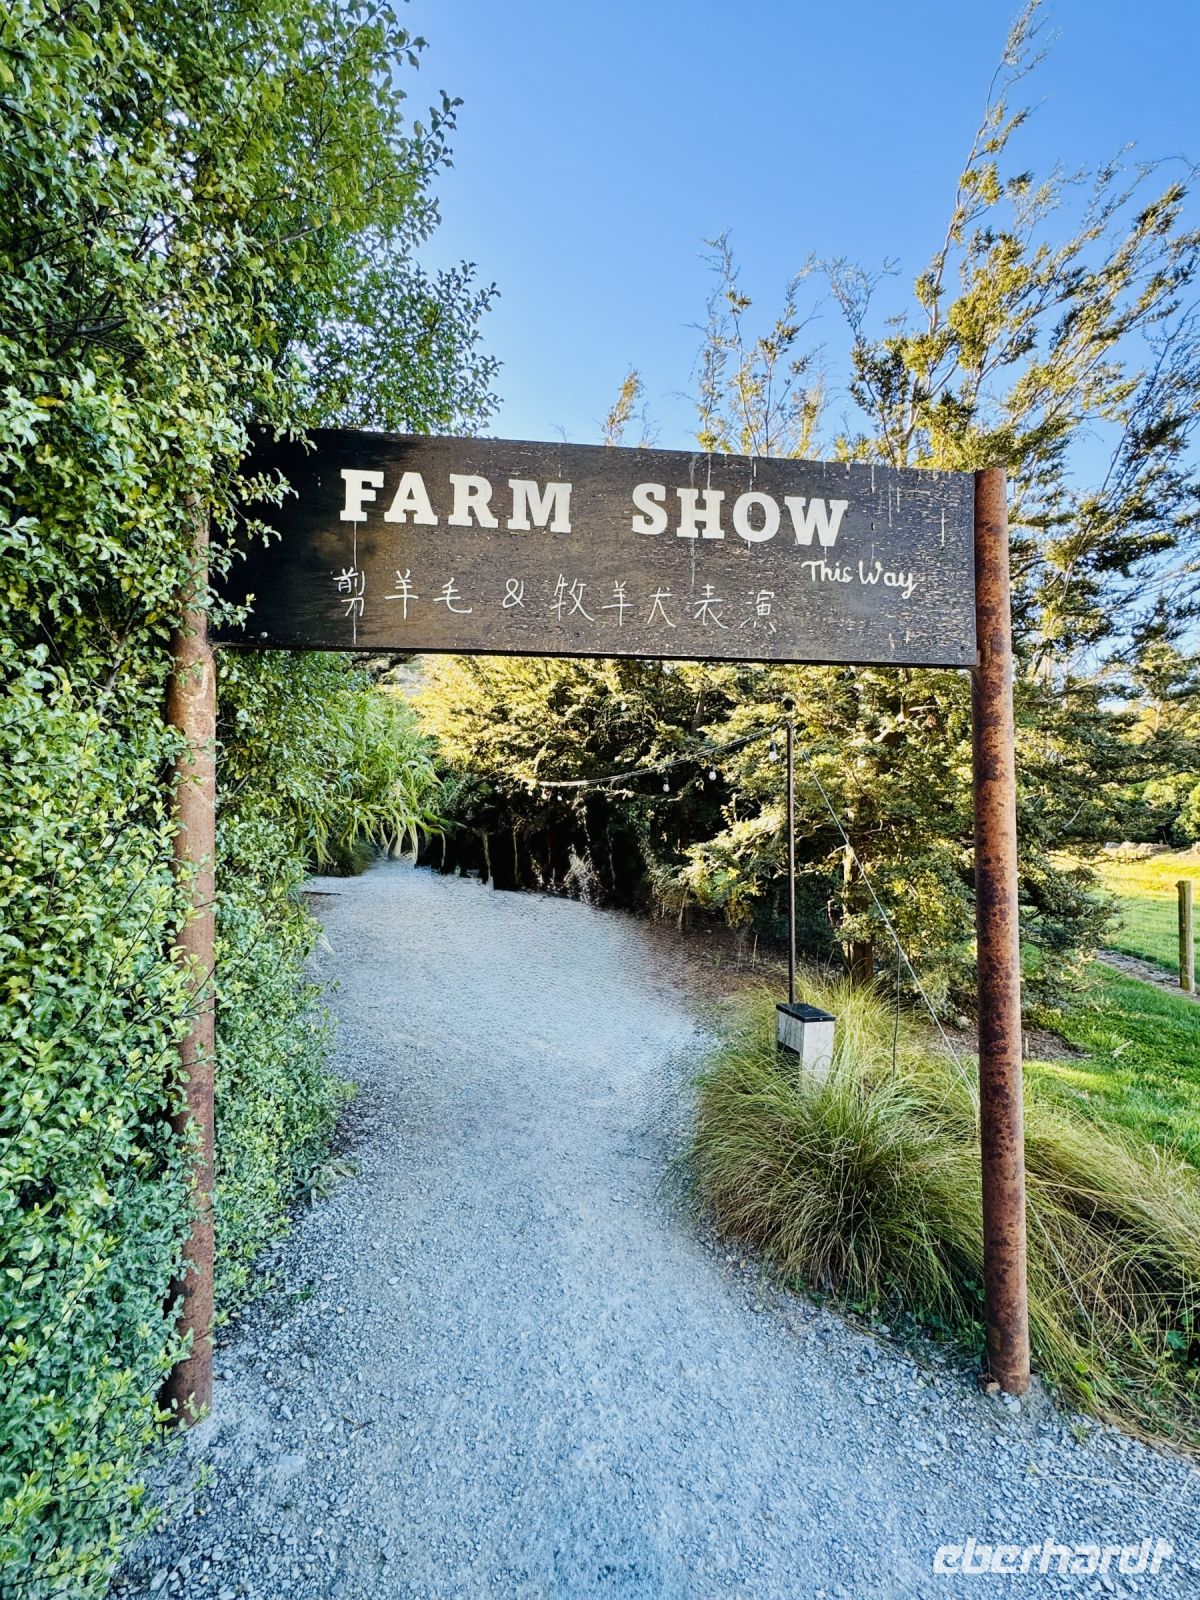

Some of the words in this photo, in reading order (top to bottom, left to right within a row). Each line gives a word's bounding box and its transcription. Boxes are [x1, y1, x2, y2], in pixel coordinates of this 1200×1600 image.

[340, 469, 572, 533] FARM
[631, 483, 848, 547] SHOW
[502, 578, 526, 608] &
[801, 560, 853, 583] This
[858, 561, 918, 599] Way
